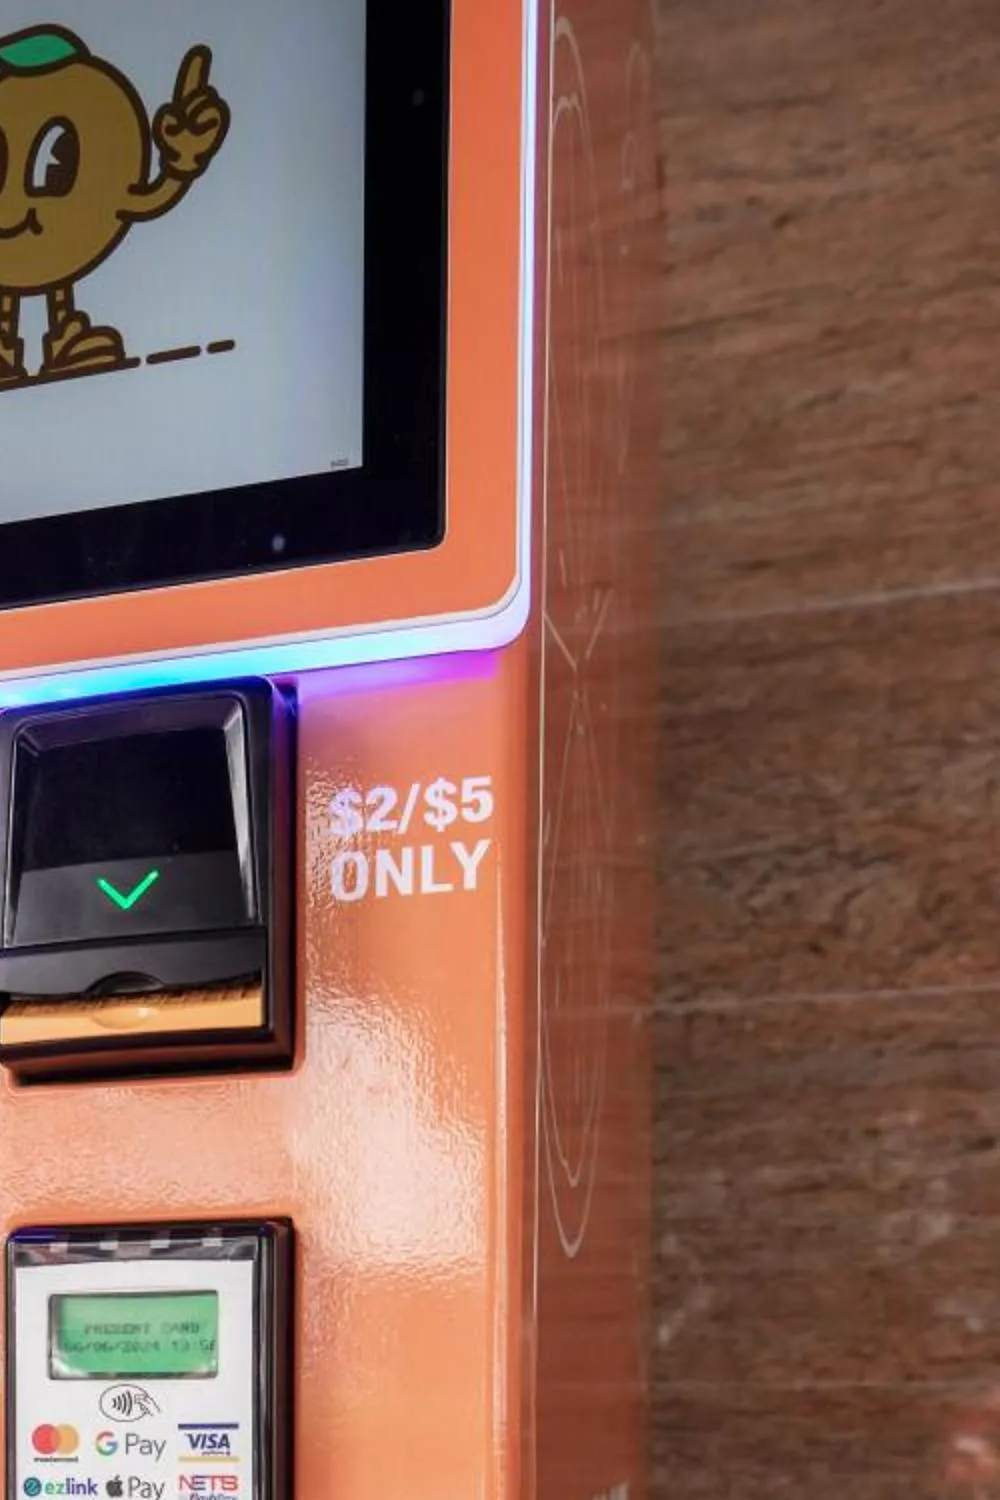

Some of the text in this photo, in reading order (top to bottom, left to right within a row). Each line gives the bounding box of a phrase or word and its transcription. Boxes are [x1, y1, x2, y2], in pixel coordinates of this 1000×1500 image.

[328, 776, 493, 838] $2/$5
[331, 840, 491, 902] ONLY
[125, 1433, 166, 1461] Pay
[187, 1434, 231, 1449] VISA
[45, 1477, 99, 1497] ezlink
[179, 1475, 239, 1491] NETS
